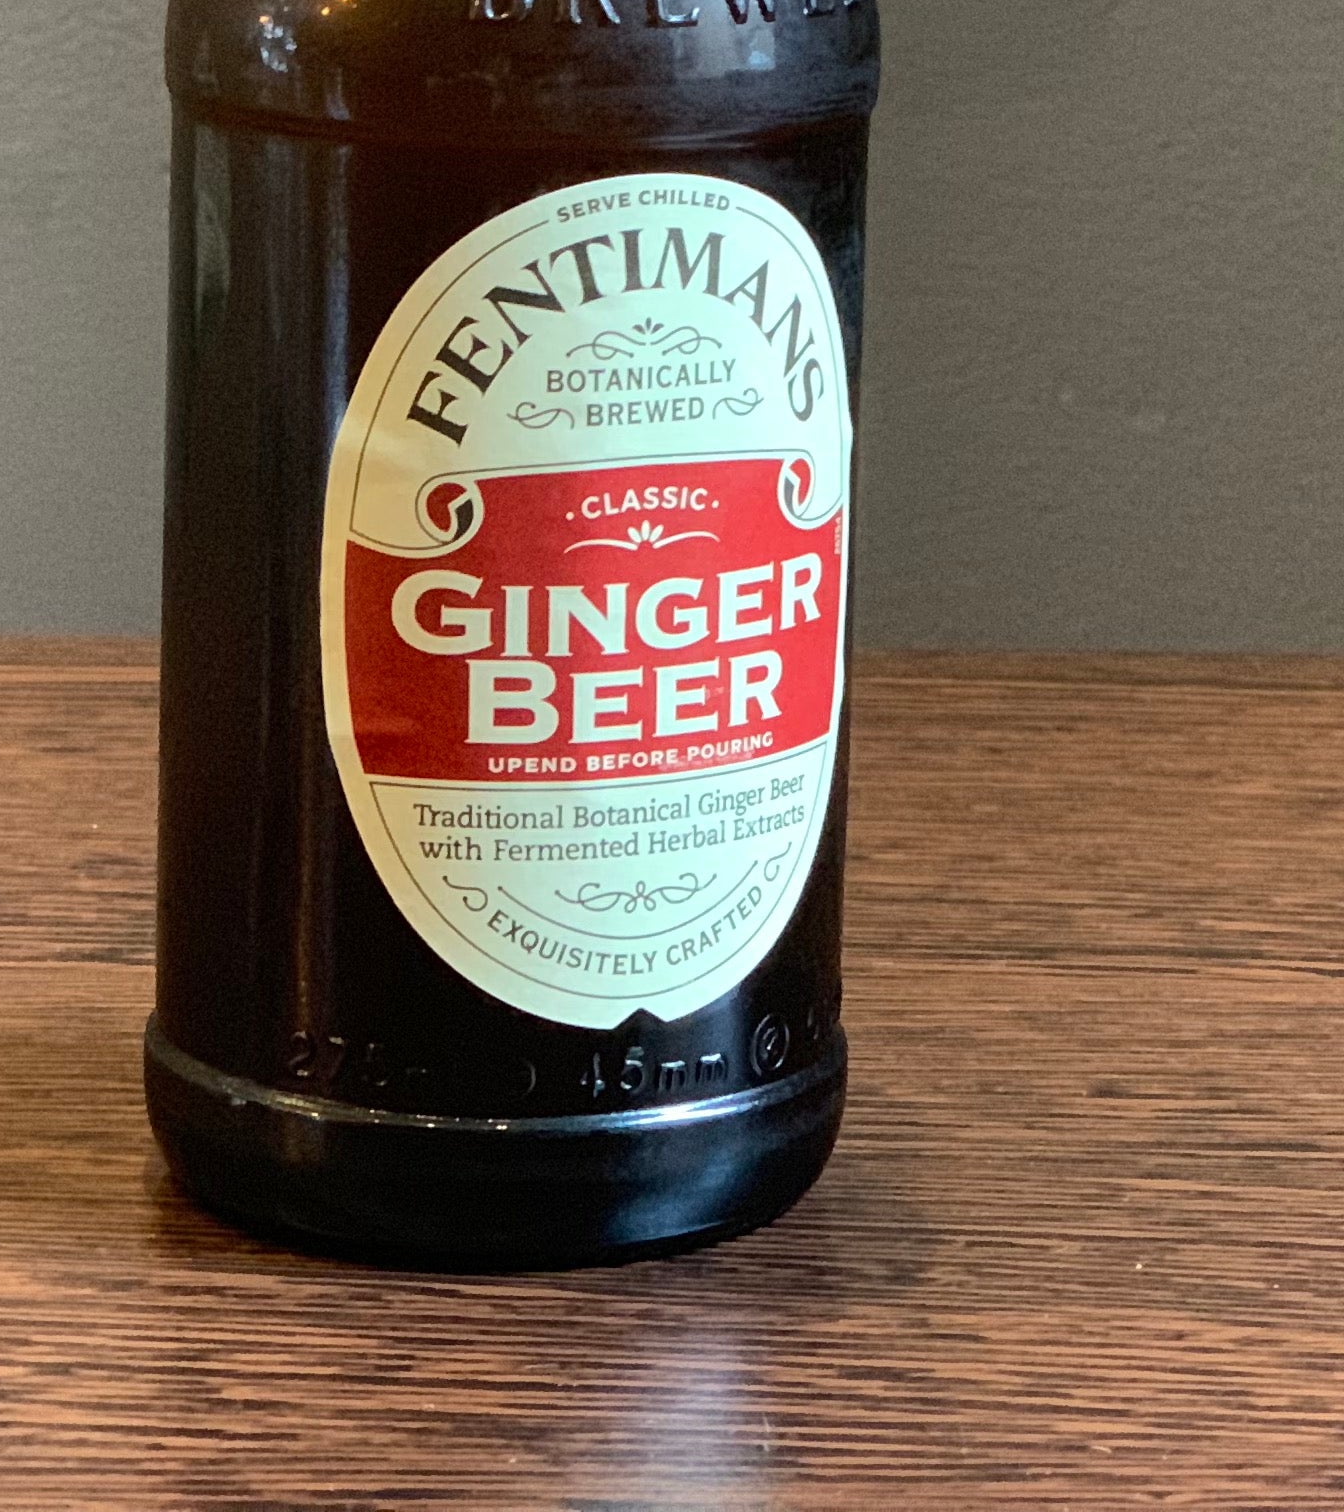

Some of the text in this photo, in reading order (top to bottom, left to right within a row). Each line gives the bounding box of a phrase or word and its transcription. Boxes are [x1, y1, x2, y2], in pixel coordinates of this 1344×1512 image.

[556, 188, 731, 223] SERVE CHILLED
[406, 226, 825, 447] FENTIMANS
[546, 358, 737, 393] BOTANICALLY
[586, 397, 705, 427] BREWED
[581, 486, 708, 520] CLASSIC
[391, 552, 822, 657] GINGER
[464, 649, 783, 745] BEER
[488, 732, 774, 774] UPEND BEFORE POURING
[413, 773, 805, 830] Traditional Botanical Ginger Beer
[419, 805, 805, 863] with Fermented Herbal Extracts
[486, 886, 765, 975] EXQUISITELY CRAFTED
